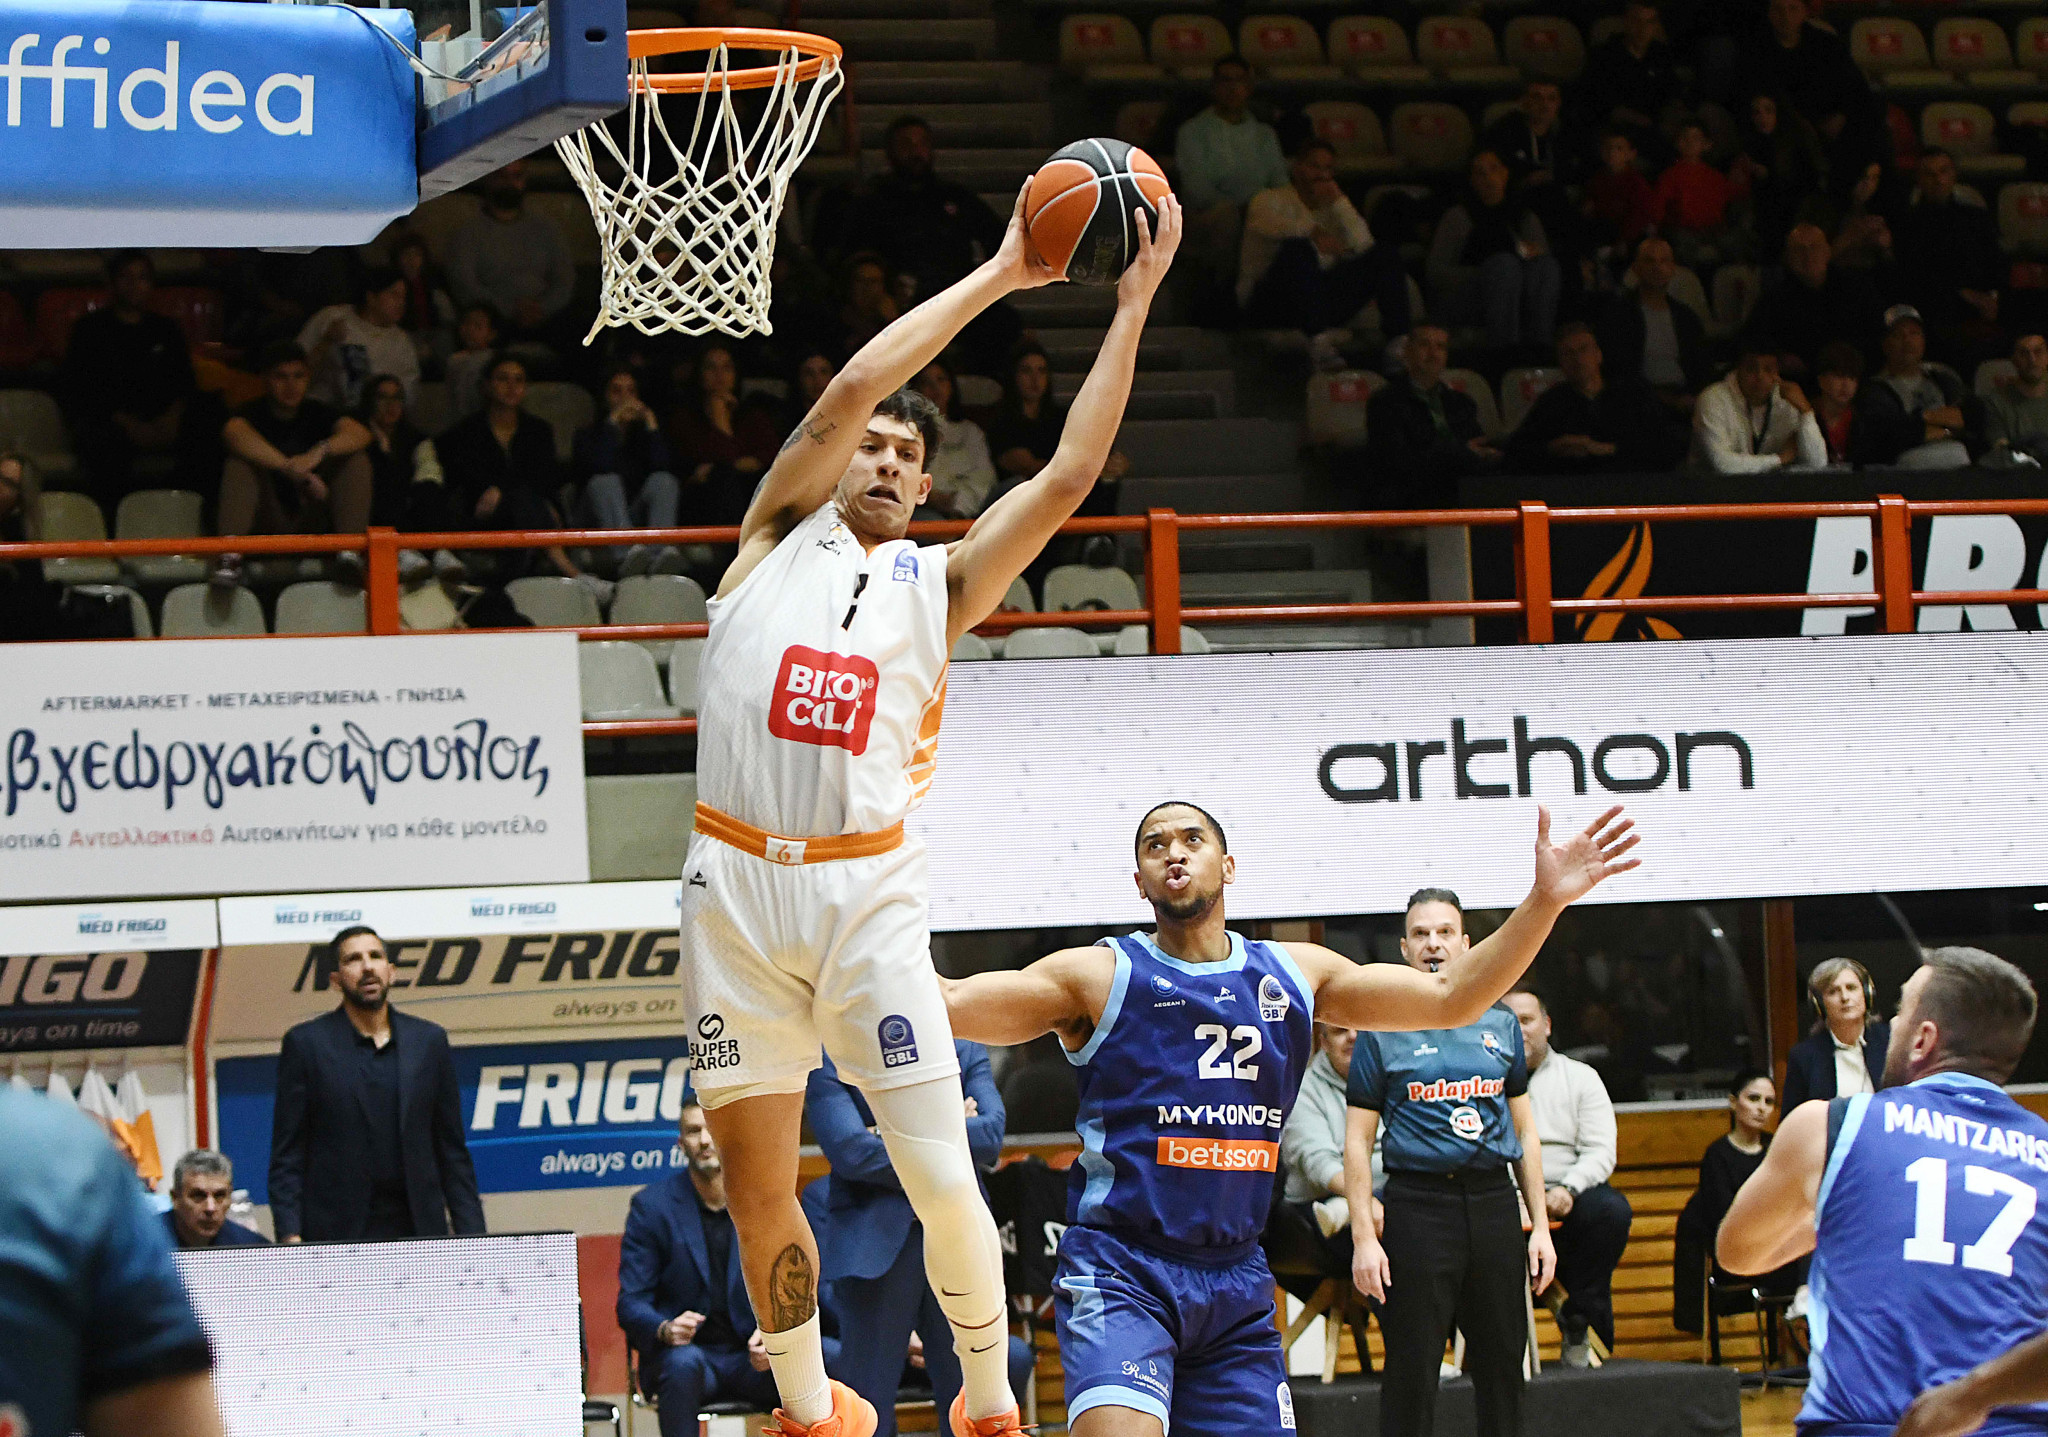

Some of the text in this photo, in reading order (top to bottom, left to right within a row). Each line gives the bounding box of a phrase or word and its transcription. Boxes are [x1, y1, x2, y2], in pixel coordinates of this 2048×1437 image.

[1800, 513, 2048, 636] PR
[42, 694, 189, 711] AFTERMARKET
[396, 687, 467, 703] ΓΝΗΣΙΑ
[1317, 714, 1755, 803] arthon
[69, 825, 215, 847] Ανταλλακτικά
[221, 820, 360, 843] Αυτοκινήτων
[367, 823, 398, 842] για
[405, 817, 455, 838] κάθε
[462, 814, 548, 838] μοντέλο
[275, 909, 362, 924] MED FRIGO
[470, 901, 557, 917] MED FRIGO
[78, 918, 168, 934] MED FRIGO
[553, 998, 676, 1019] always on
[1153, 1000, 1181, 1008] AEGEAN
[45, 1024, 78, 1041] on
[85, 1019, 140, 1038] time
[690, 1039, 739, 1057] SUPER
[885, 1050, 917, 1066] GBL
[1194, 1024, 1262, 1081] 22
[1157, 1104, 1283, 1129] MYKONOS
[1884, 1101, 2048, 1172] MANTZARIS
[540, 1149, 626, 1178] always
[631, 1151, 663, 1168] on
[1168, 1141, 1270, 1169] betsson
[1903, 1156, 2038, 1277] 17
